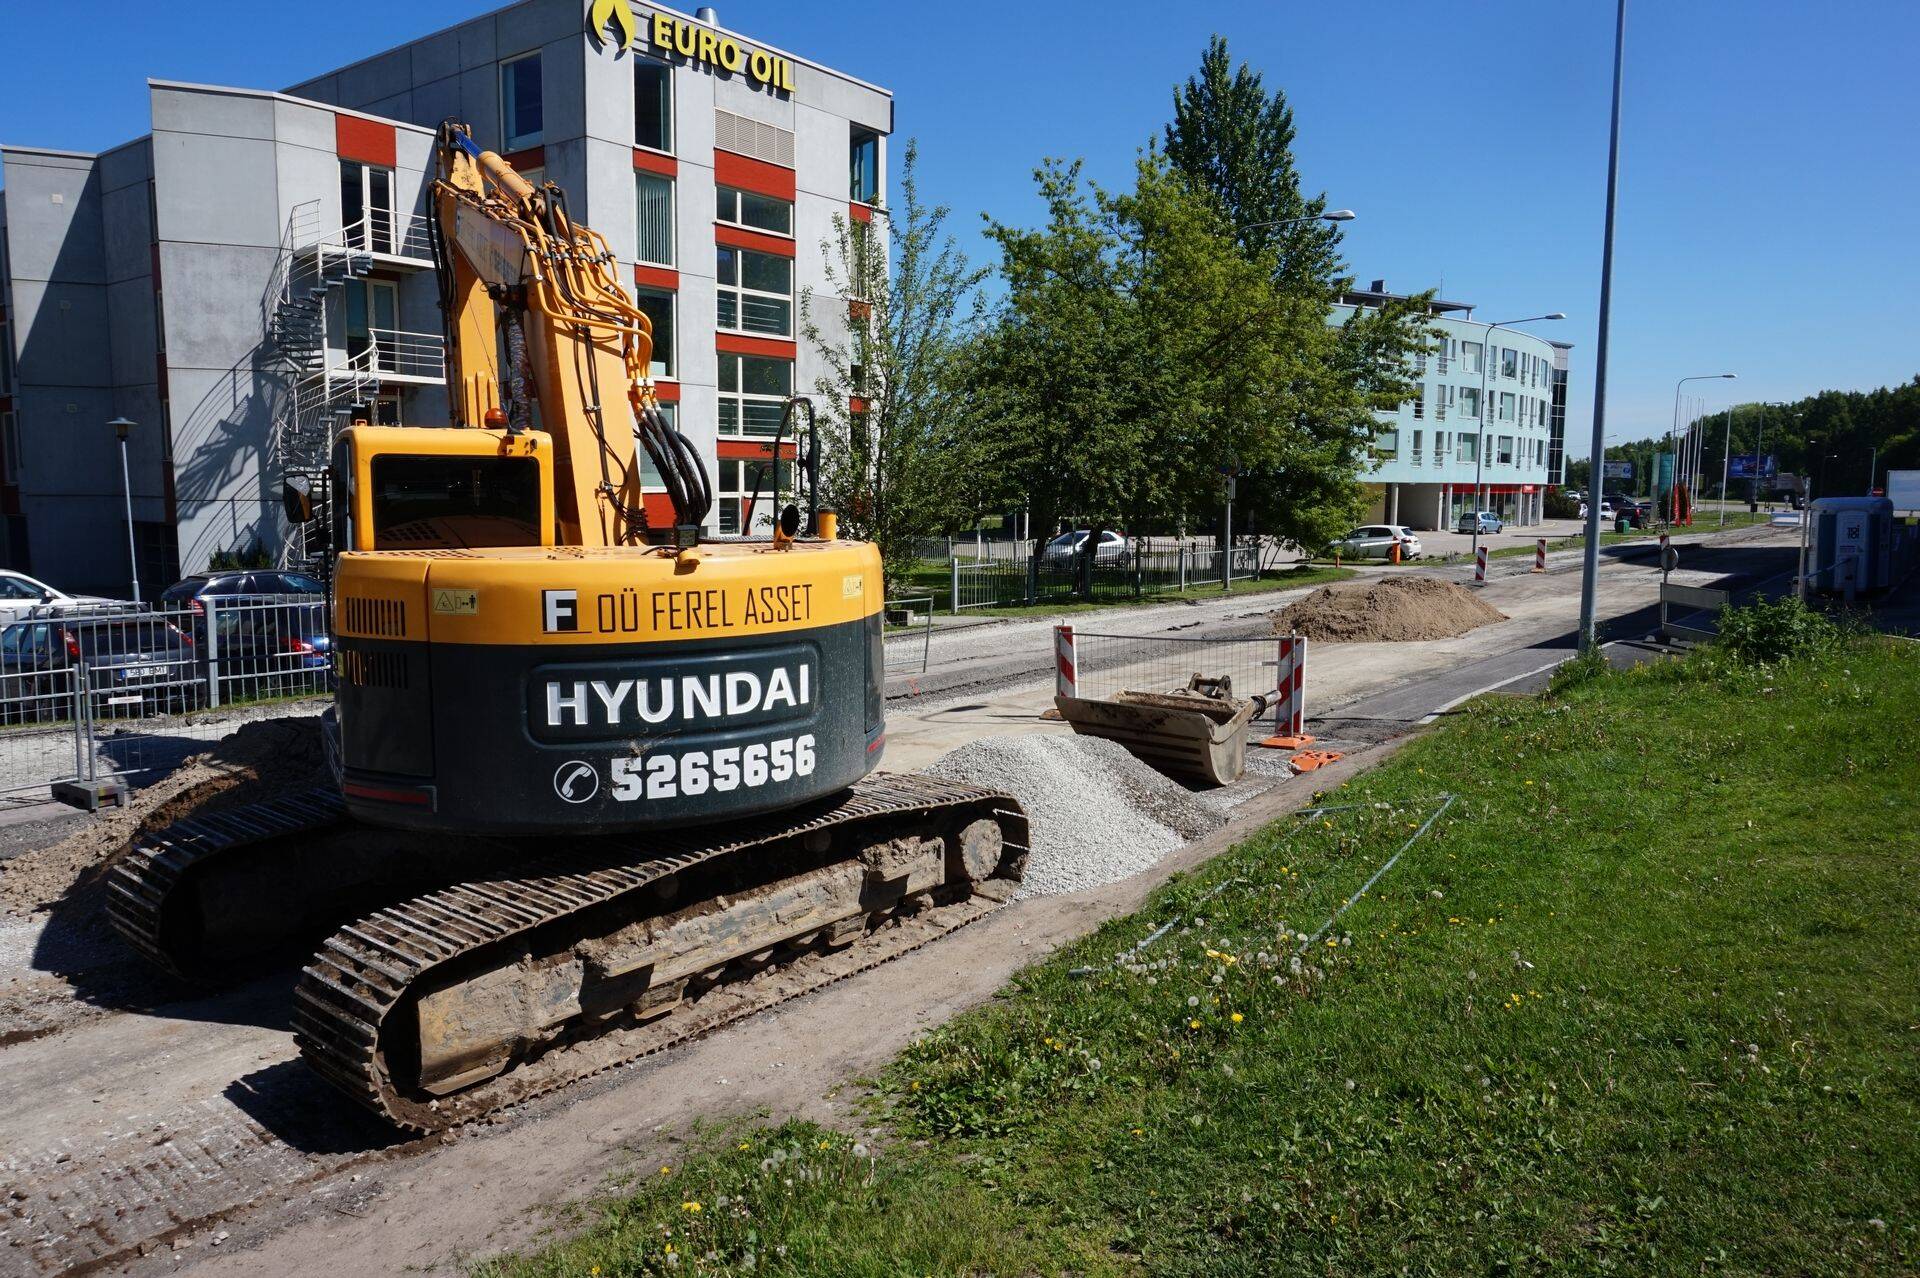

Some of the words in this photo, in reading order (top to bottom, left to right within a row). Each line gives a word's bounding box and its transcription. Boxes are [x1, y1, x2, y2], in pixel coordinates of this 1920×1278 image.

[653, 12, 741, 71] EURO
[751, 50, 796, 92] OIL
[545, 590, 577, 632] F
[597, 588, 638, 633] OÜ
[652, 589, 734, 631] FEREL
[744, 584, 813, 626] ASSET
[546, 664, 810, 726] HYUNDAI
[610, 733, 816, 801] 5265656
